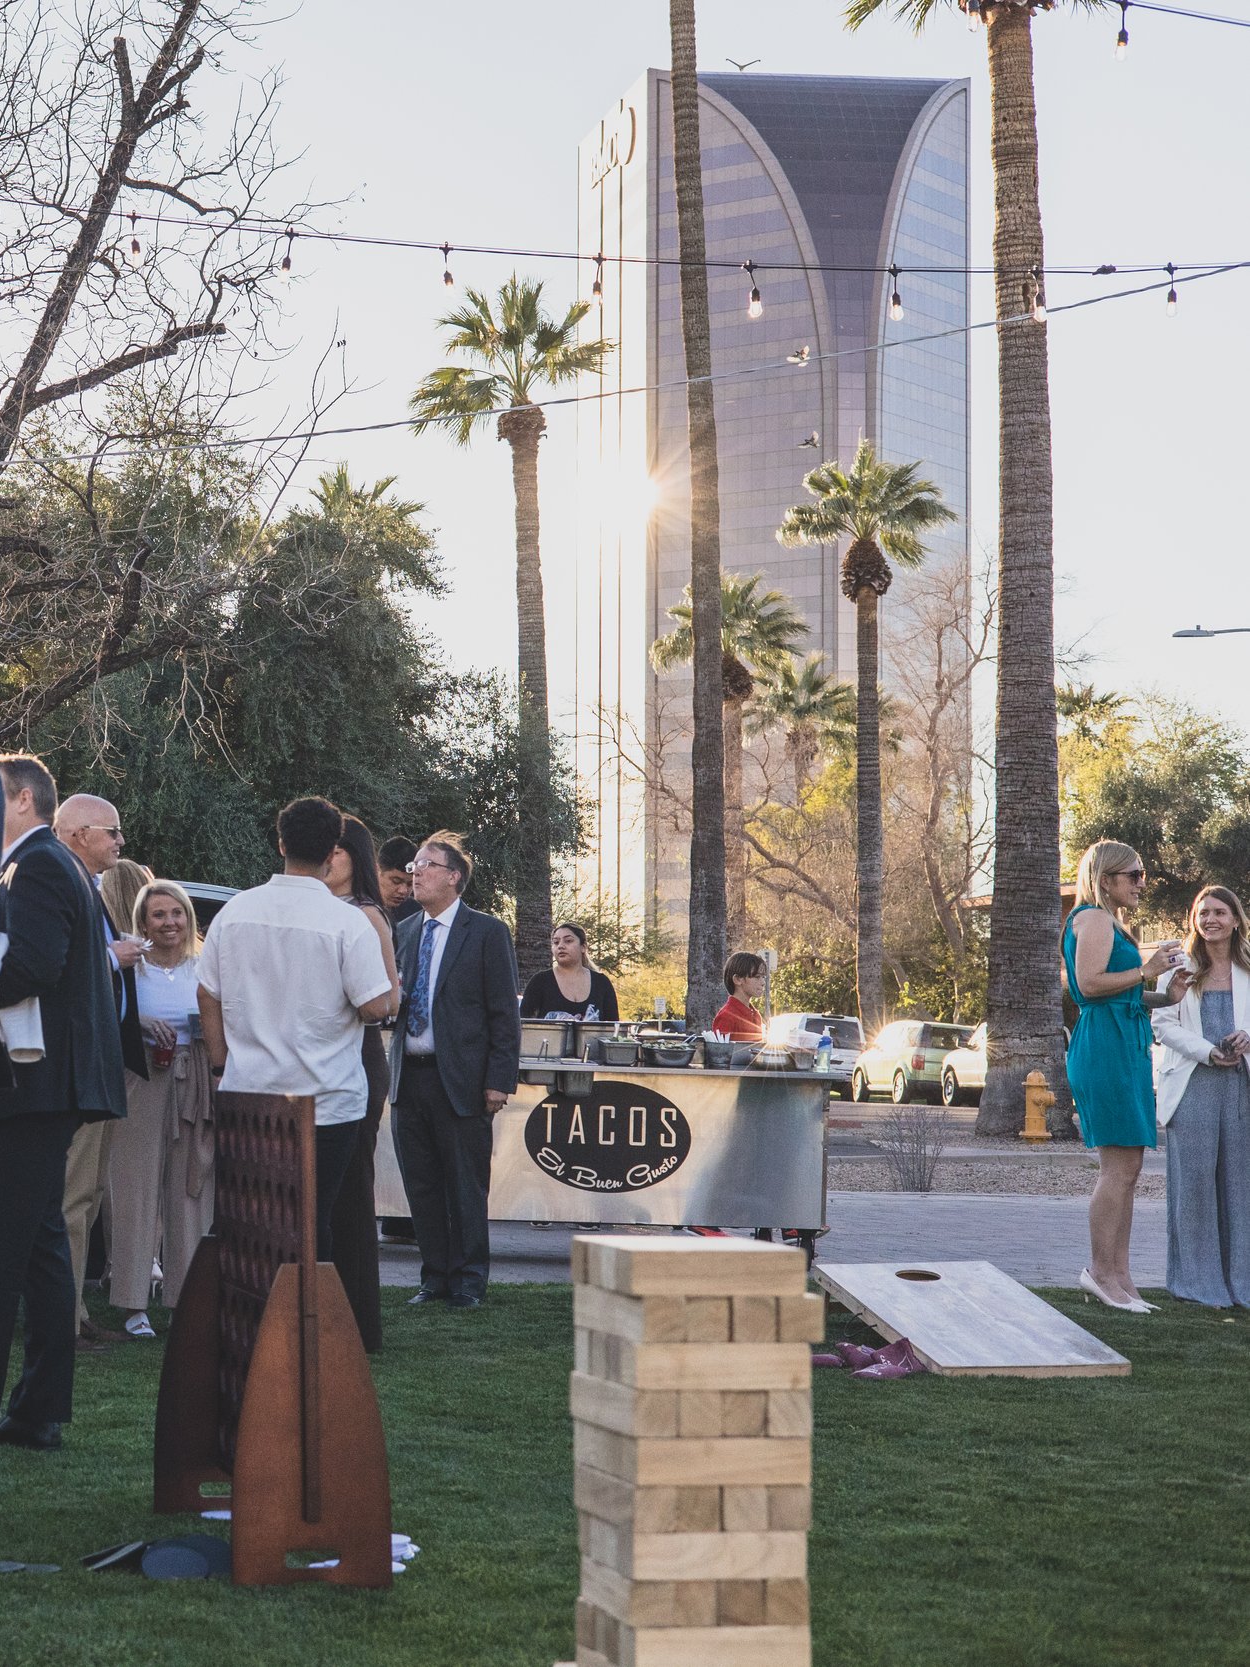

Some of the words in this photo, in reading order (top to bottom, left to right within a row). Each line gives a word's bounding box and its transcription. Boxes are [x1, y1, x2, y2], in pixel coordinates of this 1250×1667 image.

[541, 1103, 677, 1147] TACOS
[536, 1147, 566, 1176] El
[568, 1165, 623, 1189] Buen
[626, 1155, 678, 1187] Gusto
